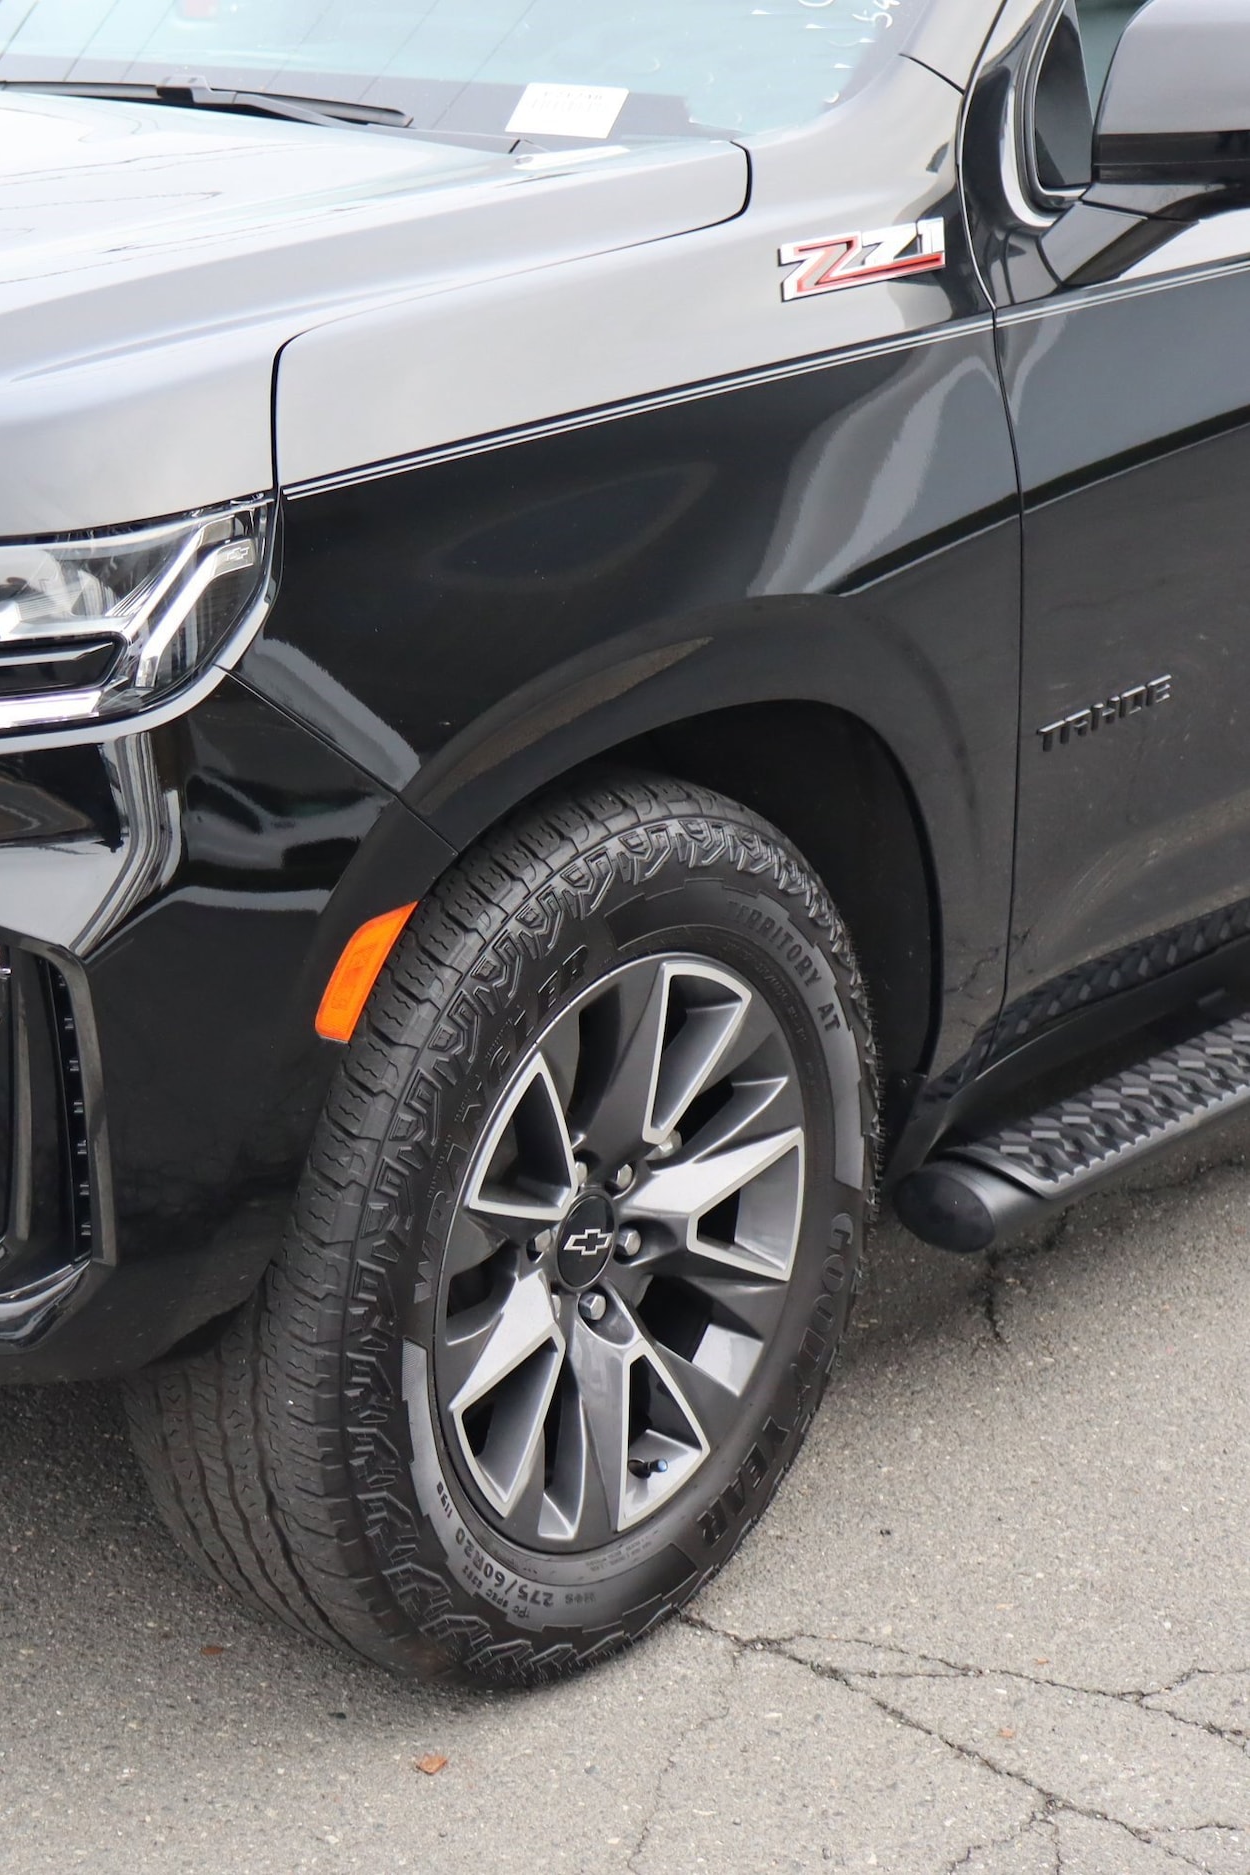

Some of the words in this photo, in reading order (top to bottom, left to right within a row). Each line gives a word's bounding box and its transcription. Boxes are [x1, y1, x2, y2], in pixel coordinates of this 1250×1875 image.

[779, 217, 946, 302] Z71
[1036, 674, 1172, 752] TAHOE
[726, 901, 821, 987] TERRITORY
[817, 1002, 841, 1032] AT
[414, 943, 590, 1303] WRANGLER
[696, 1212, 855, 1547] GOODYEAR
[455, 1527, 554, 1607] 275/60R20
